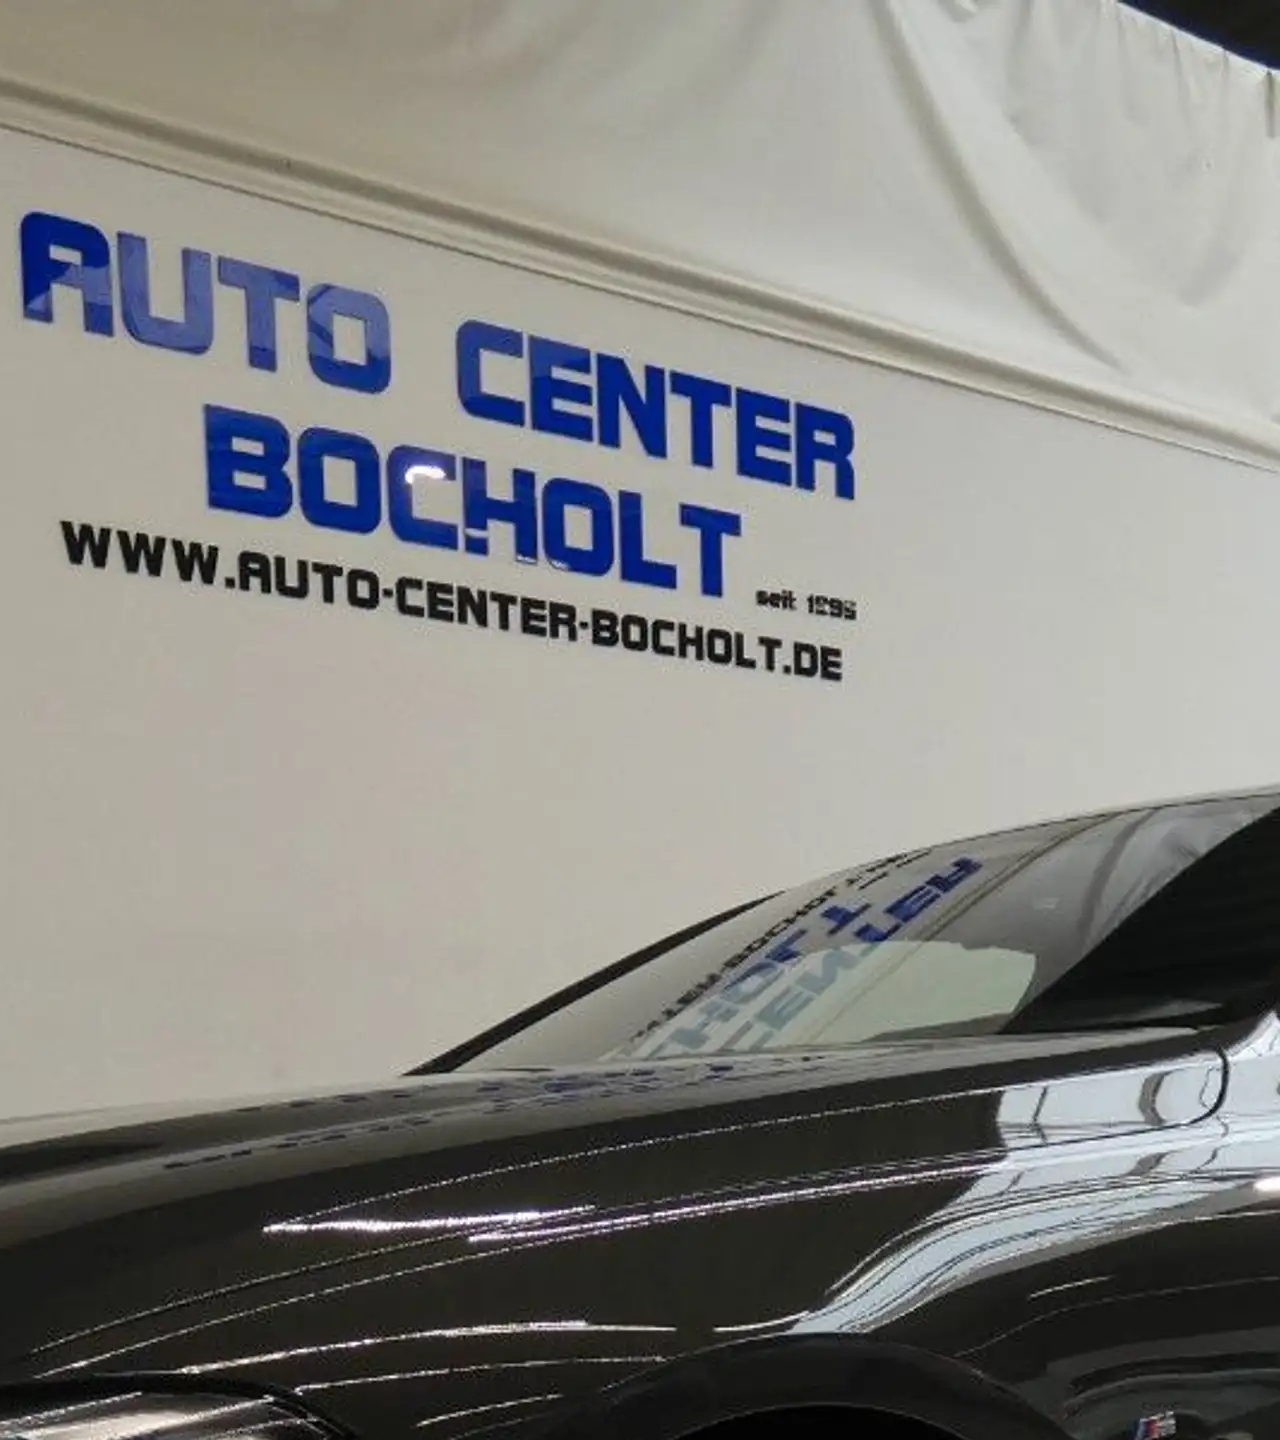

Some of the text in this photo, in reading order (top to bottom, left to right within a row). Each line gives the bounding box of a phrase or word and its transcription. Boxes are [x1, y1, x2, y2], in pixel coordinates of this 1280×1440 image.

[19, 211, 856, 500] AUTO CENTER
[204, 403, 743, 599] BOCHOLT
[60, 520, 844, 682] WWW.AUTO-CENTER-BOCHOLT.DE
